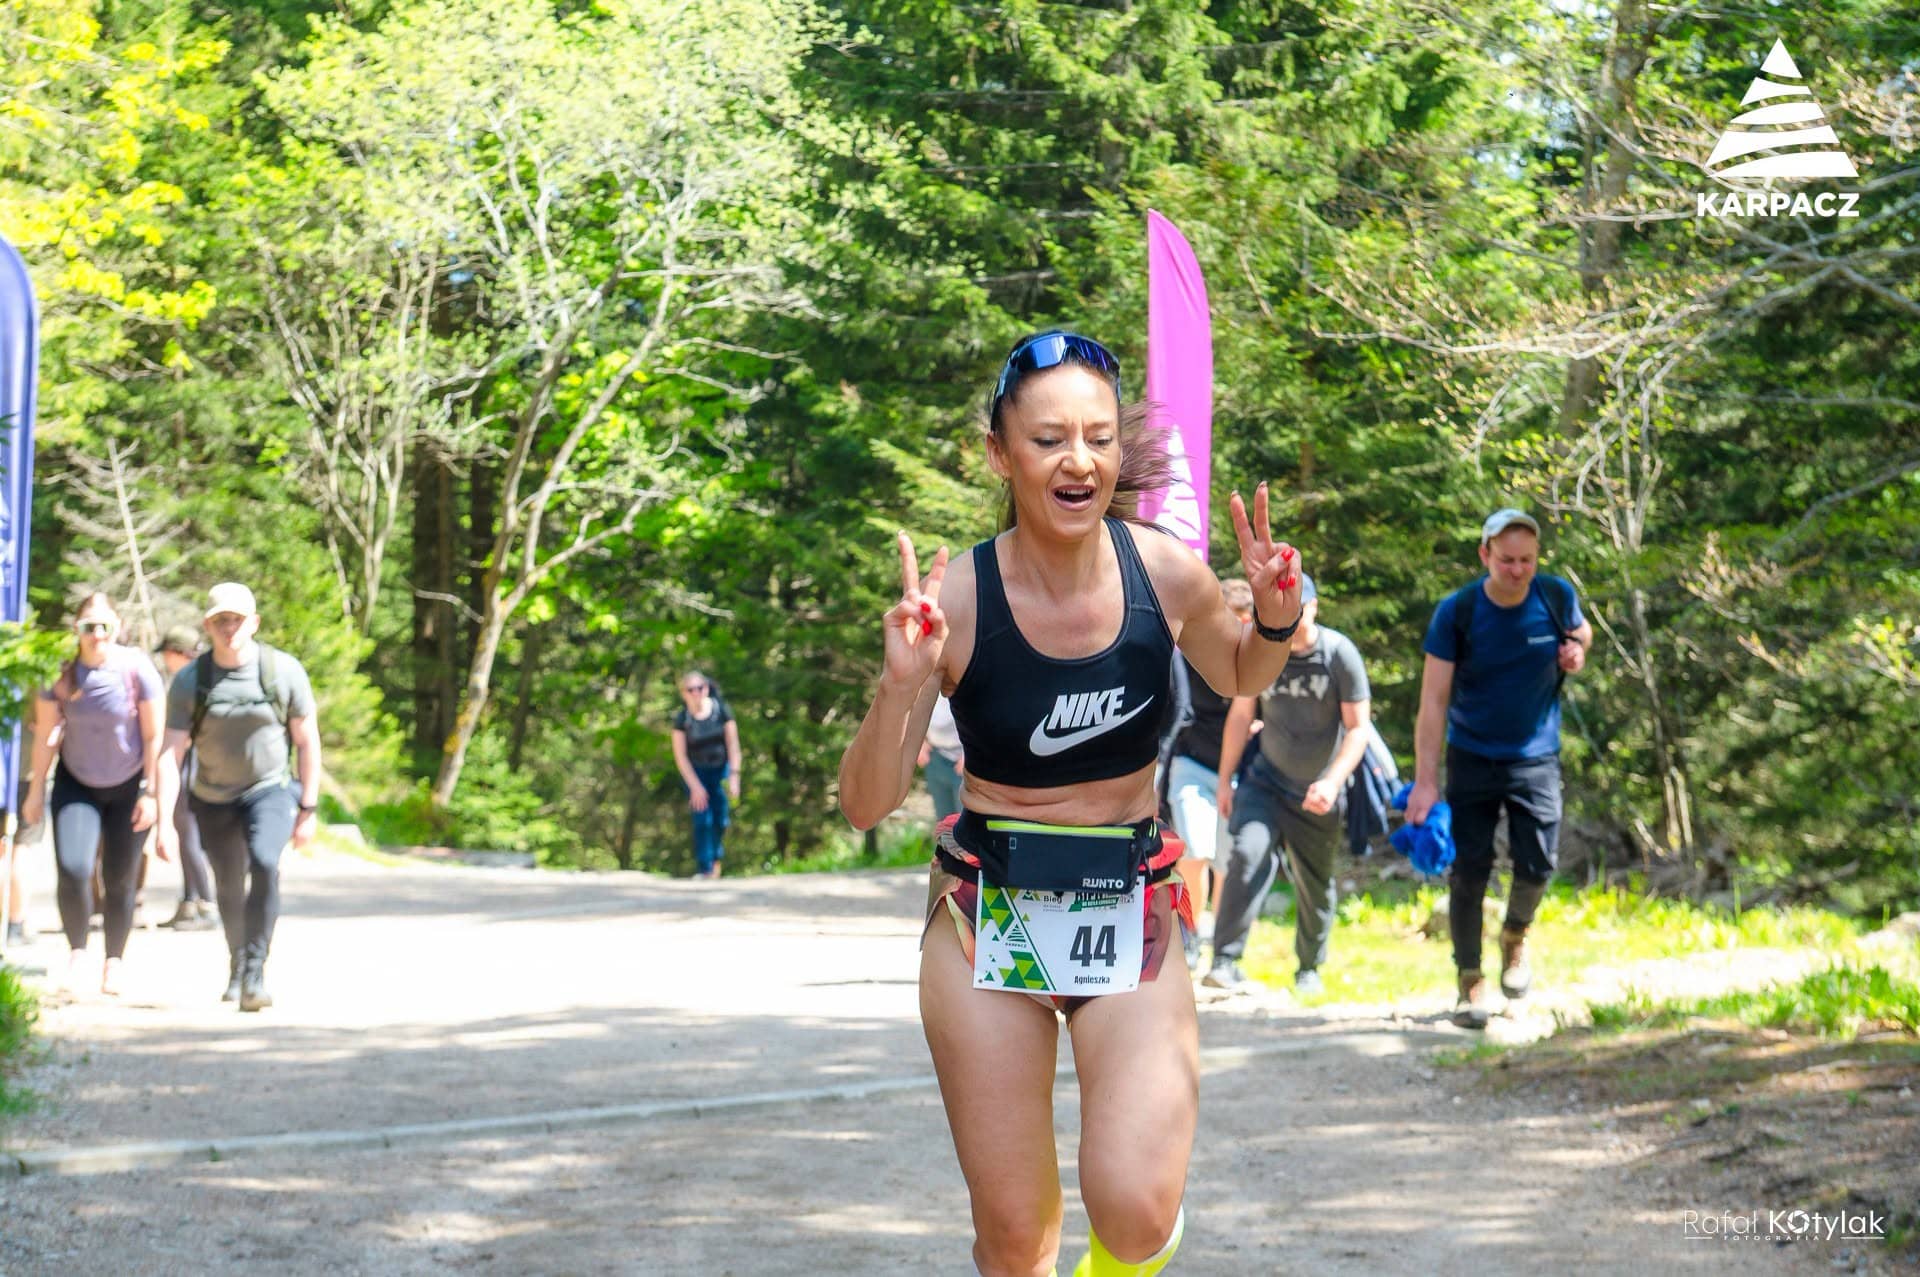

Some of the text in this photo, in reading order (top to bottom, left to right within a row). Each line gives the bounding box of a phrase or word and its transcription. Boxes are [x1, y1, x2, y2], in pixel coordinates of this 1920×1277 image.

[1046, 685, 1126, 730] NIKE
[1082, 878, 1124, 889] RUNTO
[1069, 925, 1117, 967] 44
[1074, 975, 1111, 985] Agnieszka
